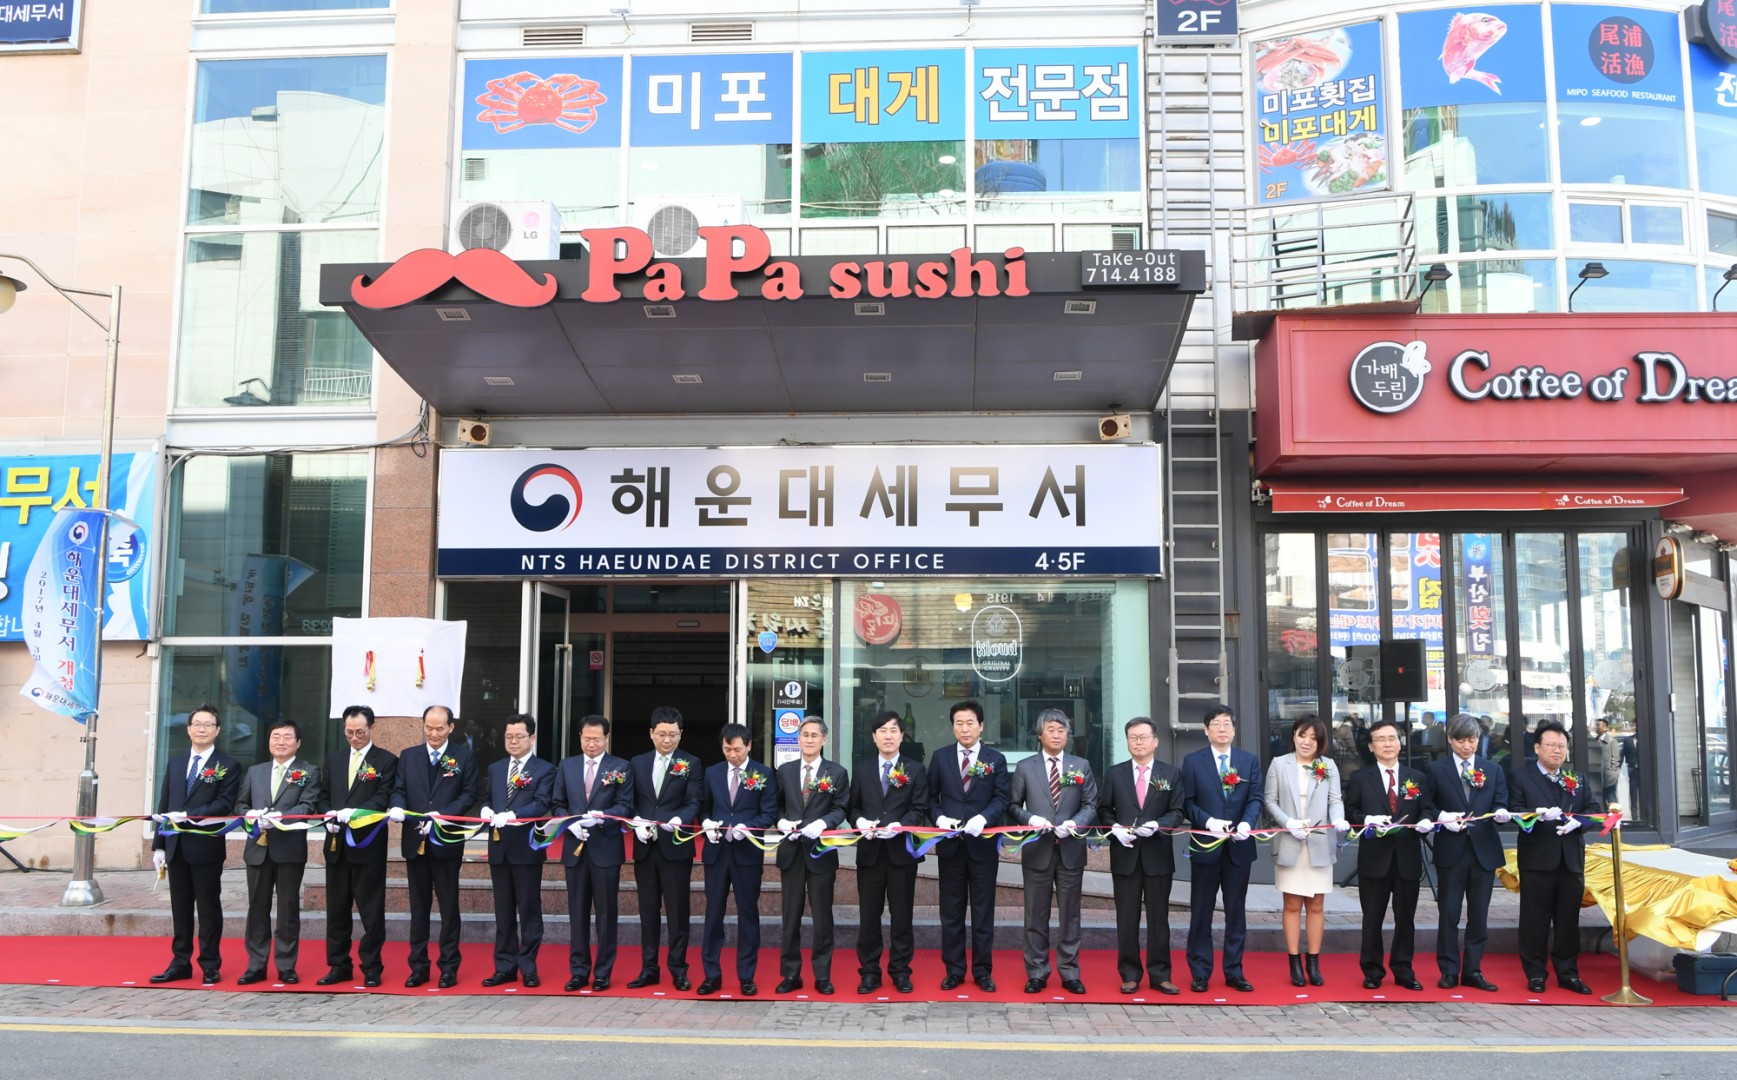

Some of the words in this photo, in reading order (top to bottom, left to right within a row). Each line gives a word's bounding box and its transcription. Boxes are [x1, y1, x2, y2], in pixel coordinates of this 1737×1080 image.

[0, 3, 64, 22] 대세무서
[1177, 10, 1222, 32] 2F
[648, 69, 772, 130] 미포
[828, 64, 940, 125] 대게
[980, 62, 1129, 122] 전문점
[1262, 74, 1376, 116] 미포횟집
[1566, 88, 1588, 97] MIPO
[1591, 89, 1629, 98] SEAFOOD
[1631, 91, 1677, 103] RESTAURANT
[1262, 104, 1377, 146] 미포대게
[1265, 182, 1288, 200] 2F
[523, 230, 539, 240] LG
[829, 246, 1031, 299] sushi
[1086, 266, 1177, 284] 714.4188
[1362, 359, 1398, 380] 가배
[1449, 349, 1584, 400] Coffee
[1590, 366, 1630, 399] of
[1371, 380, 1407, 401] 두림
[610, 464, 1086, 528] 해운대세무서
[1336, 496, 1364, 508] Coffee
[1374, 496, 1405, 508] Dream
[1574, 495, 1603, 505] Coffee
[1612, 495, 1645, 505] Dream
[521, 554, 567, 570] NTS
[579, 554, 711, 570] HAEUNDAE
[725, 554, 840, 570] DISTRICT
[853, 553, 945, 569] OFFICE
[35, 571, 47, 613] 2017년
[57, 551, 82, 653] 해운대세무서
[57, 659, 75, 691] 개청
[789, 684, 798, 696] P
[781, 718, 799, 728] 담배
